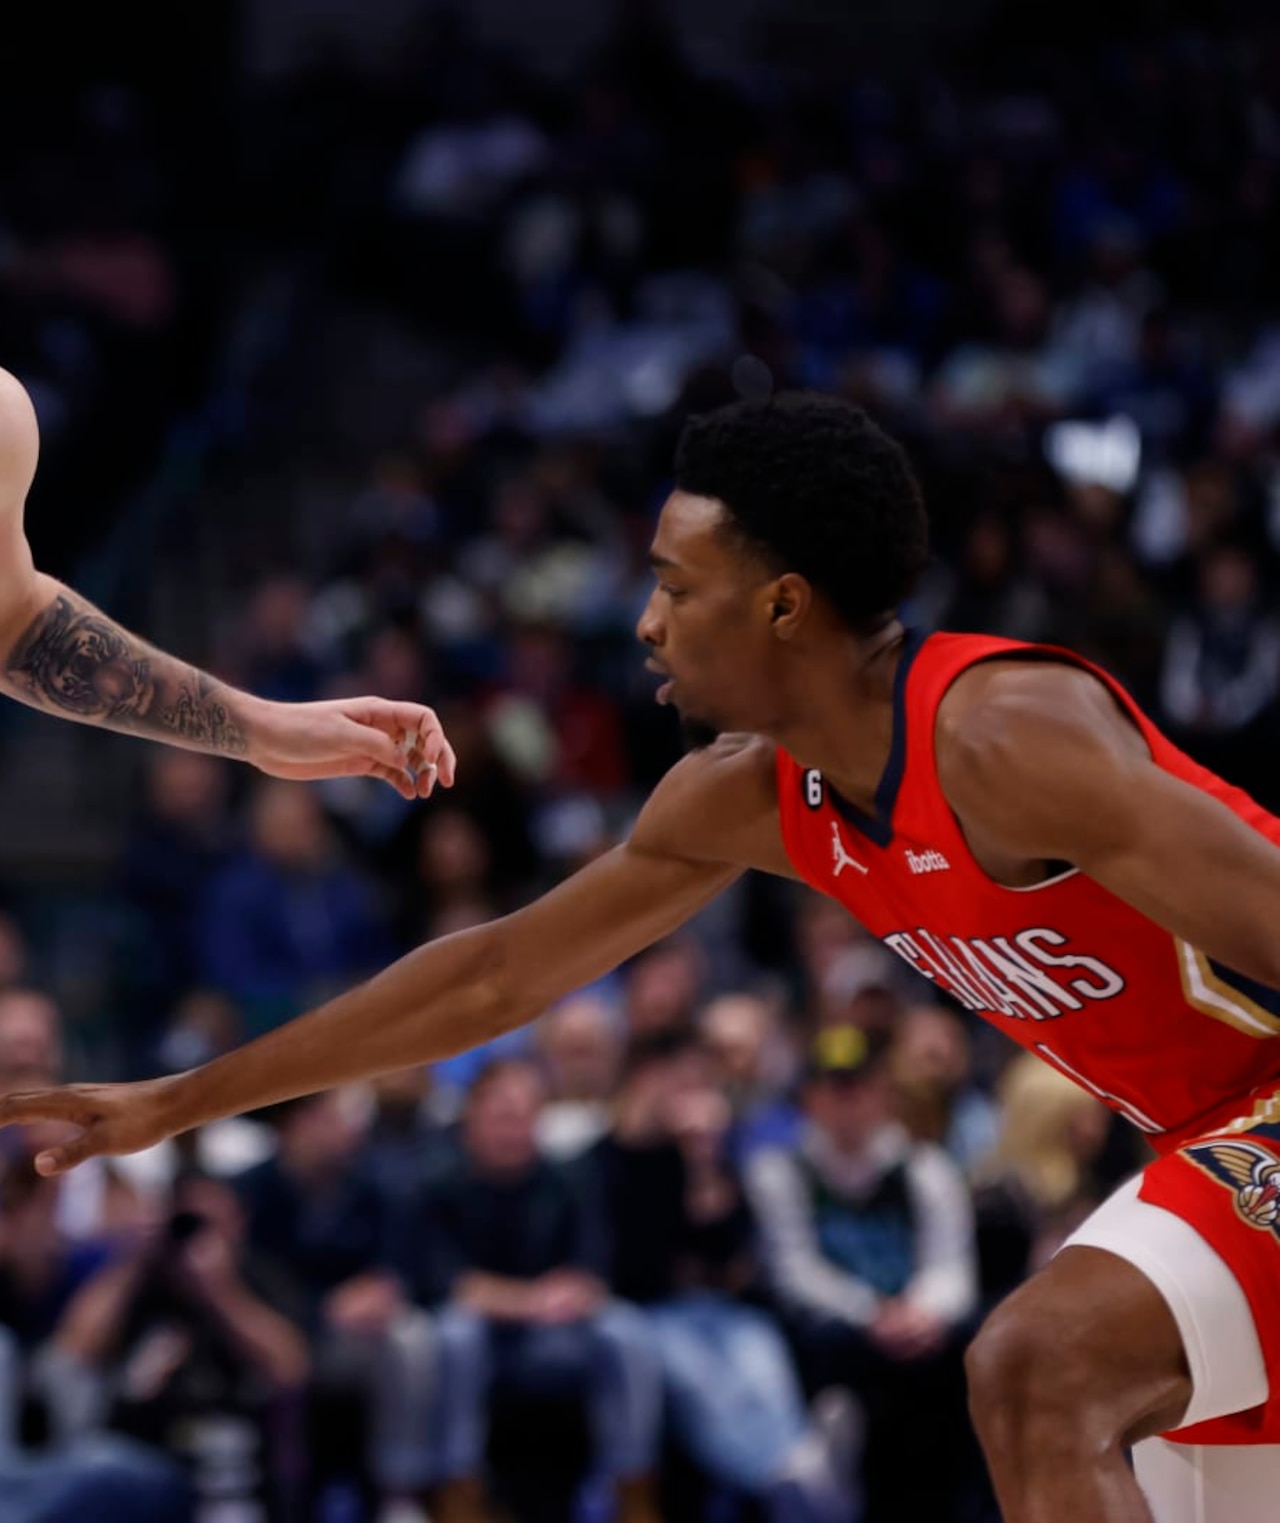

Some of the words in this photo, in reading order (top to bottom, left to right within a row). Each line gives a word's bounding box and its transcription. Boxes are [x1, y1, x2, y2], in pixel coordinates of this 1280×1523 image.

[807, 768, 822, 807] 6
[904, 849, 951, 875] ibotta
[883, 927, 1125, 1020] ELICANS
